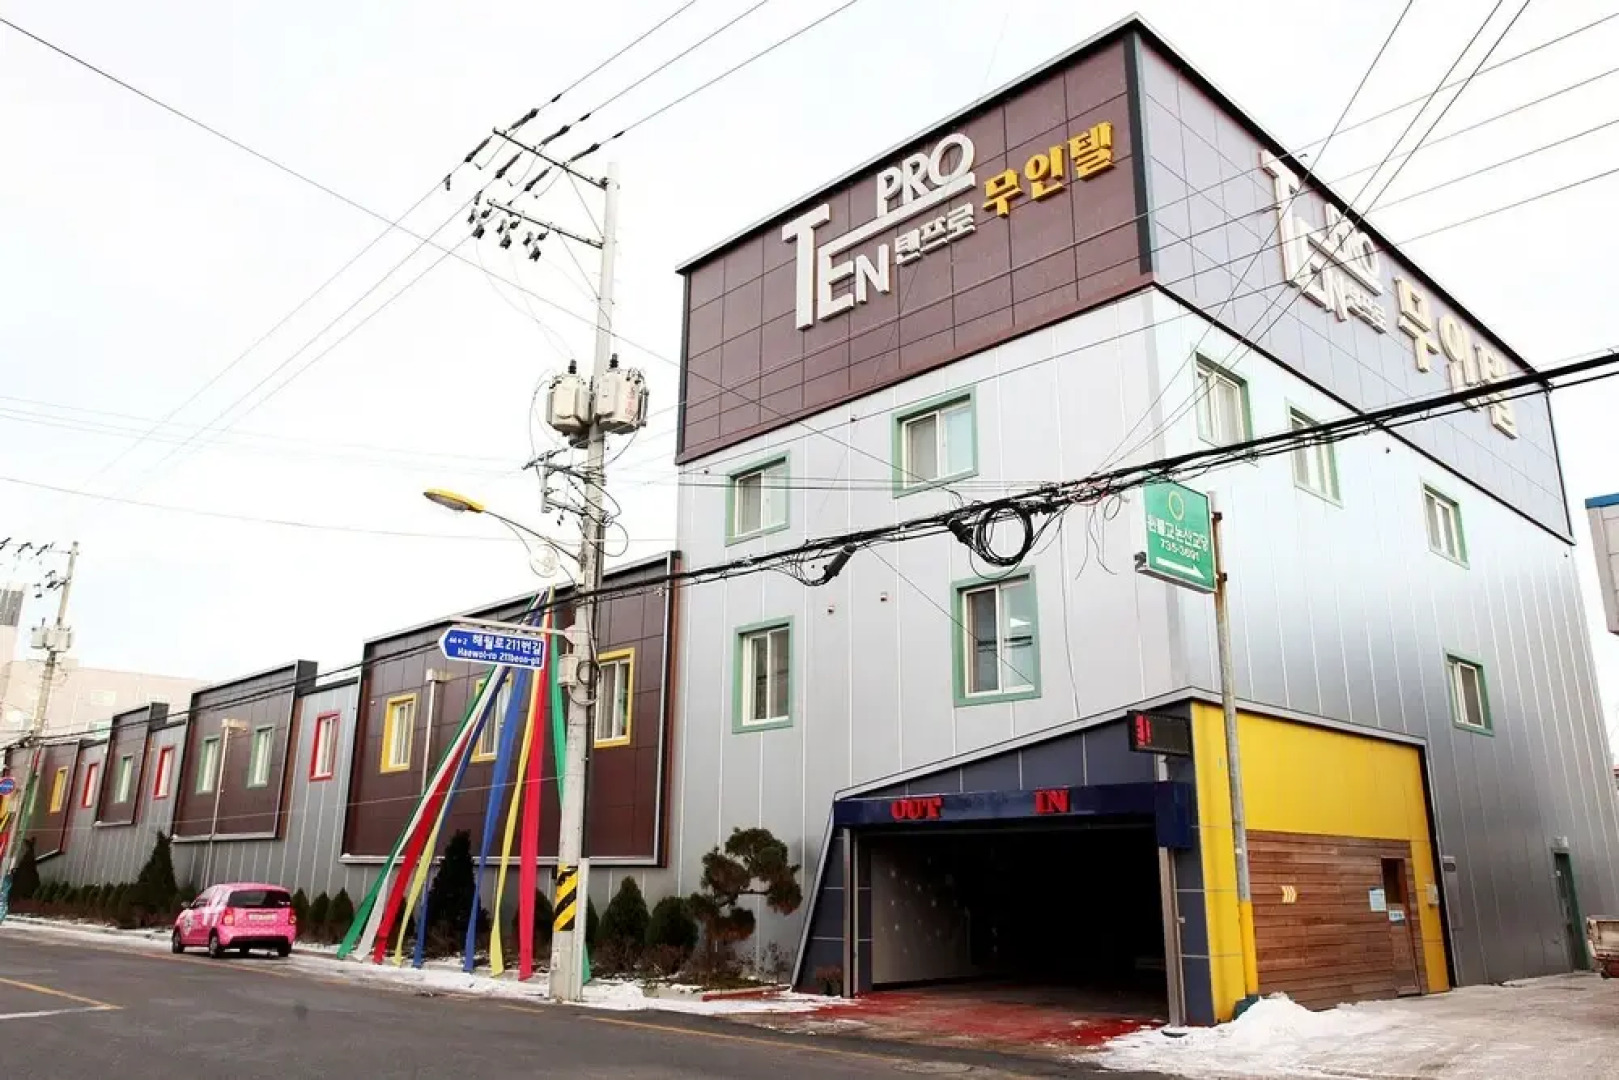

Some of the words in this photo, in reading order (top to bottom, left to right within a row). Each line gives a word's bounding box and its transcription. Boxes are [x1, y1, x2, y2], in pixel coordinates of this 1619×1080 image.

[876, 132, 976, 218] PRO
[983, 121, 1115, 218] 무인텔
[895, 203, 976, 266] 텐프로
[782, 203, 890, 330] TEN
[457, 647, 498, 660] Haewol-ro
[890, 797, 943, 821] OUT
[1034, 786, 1071, 814] IN
